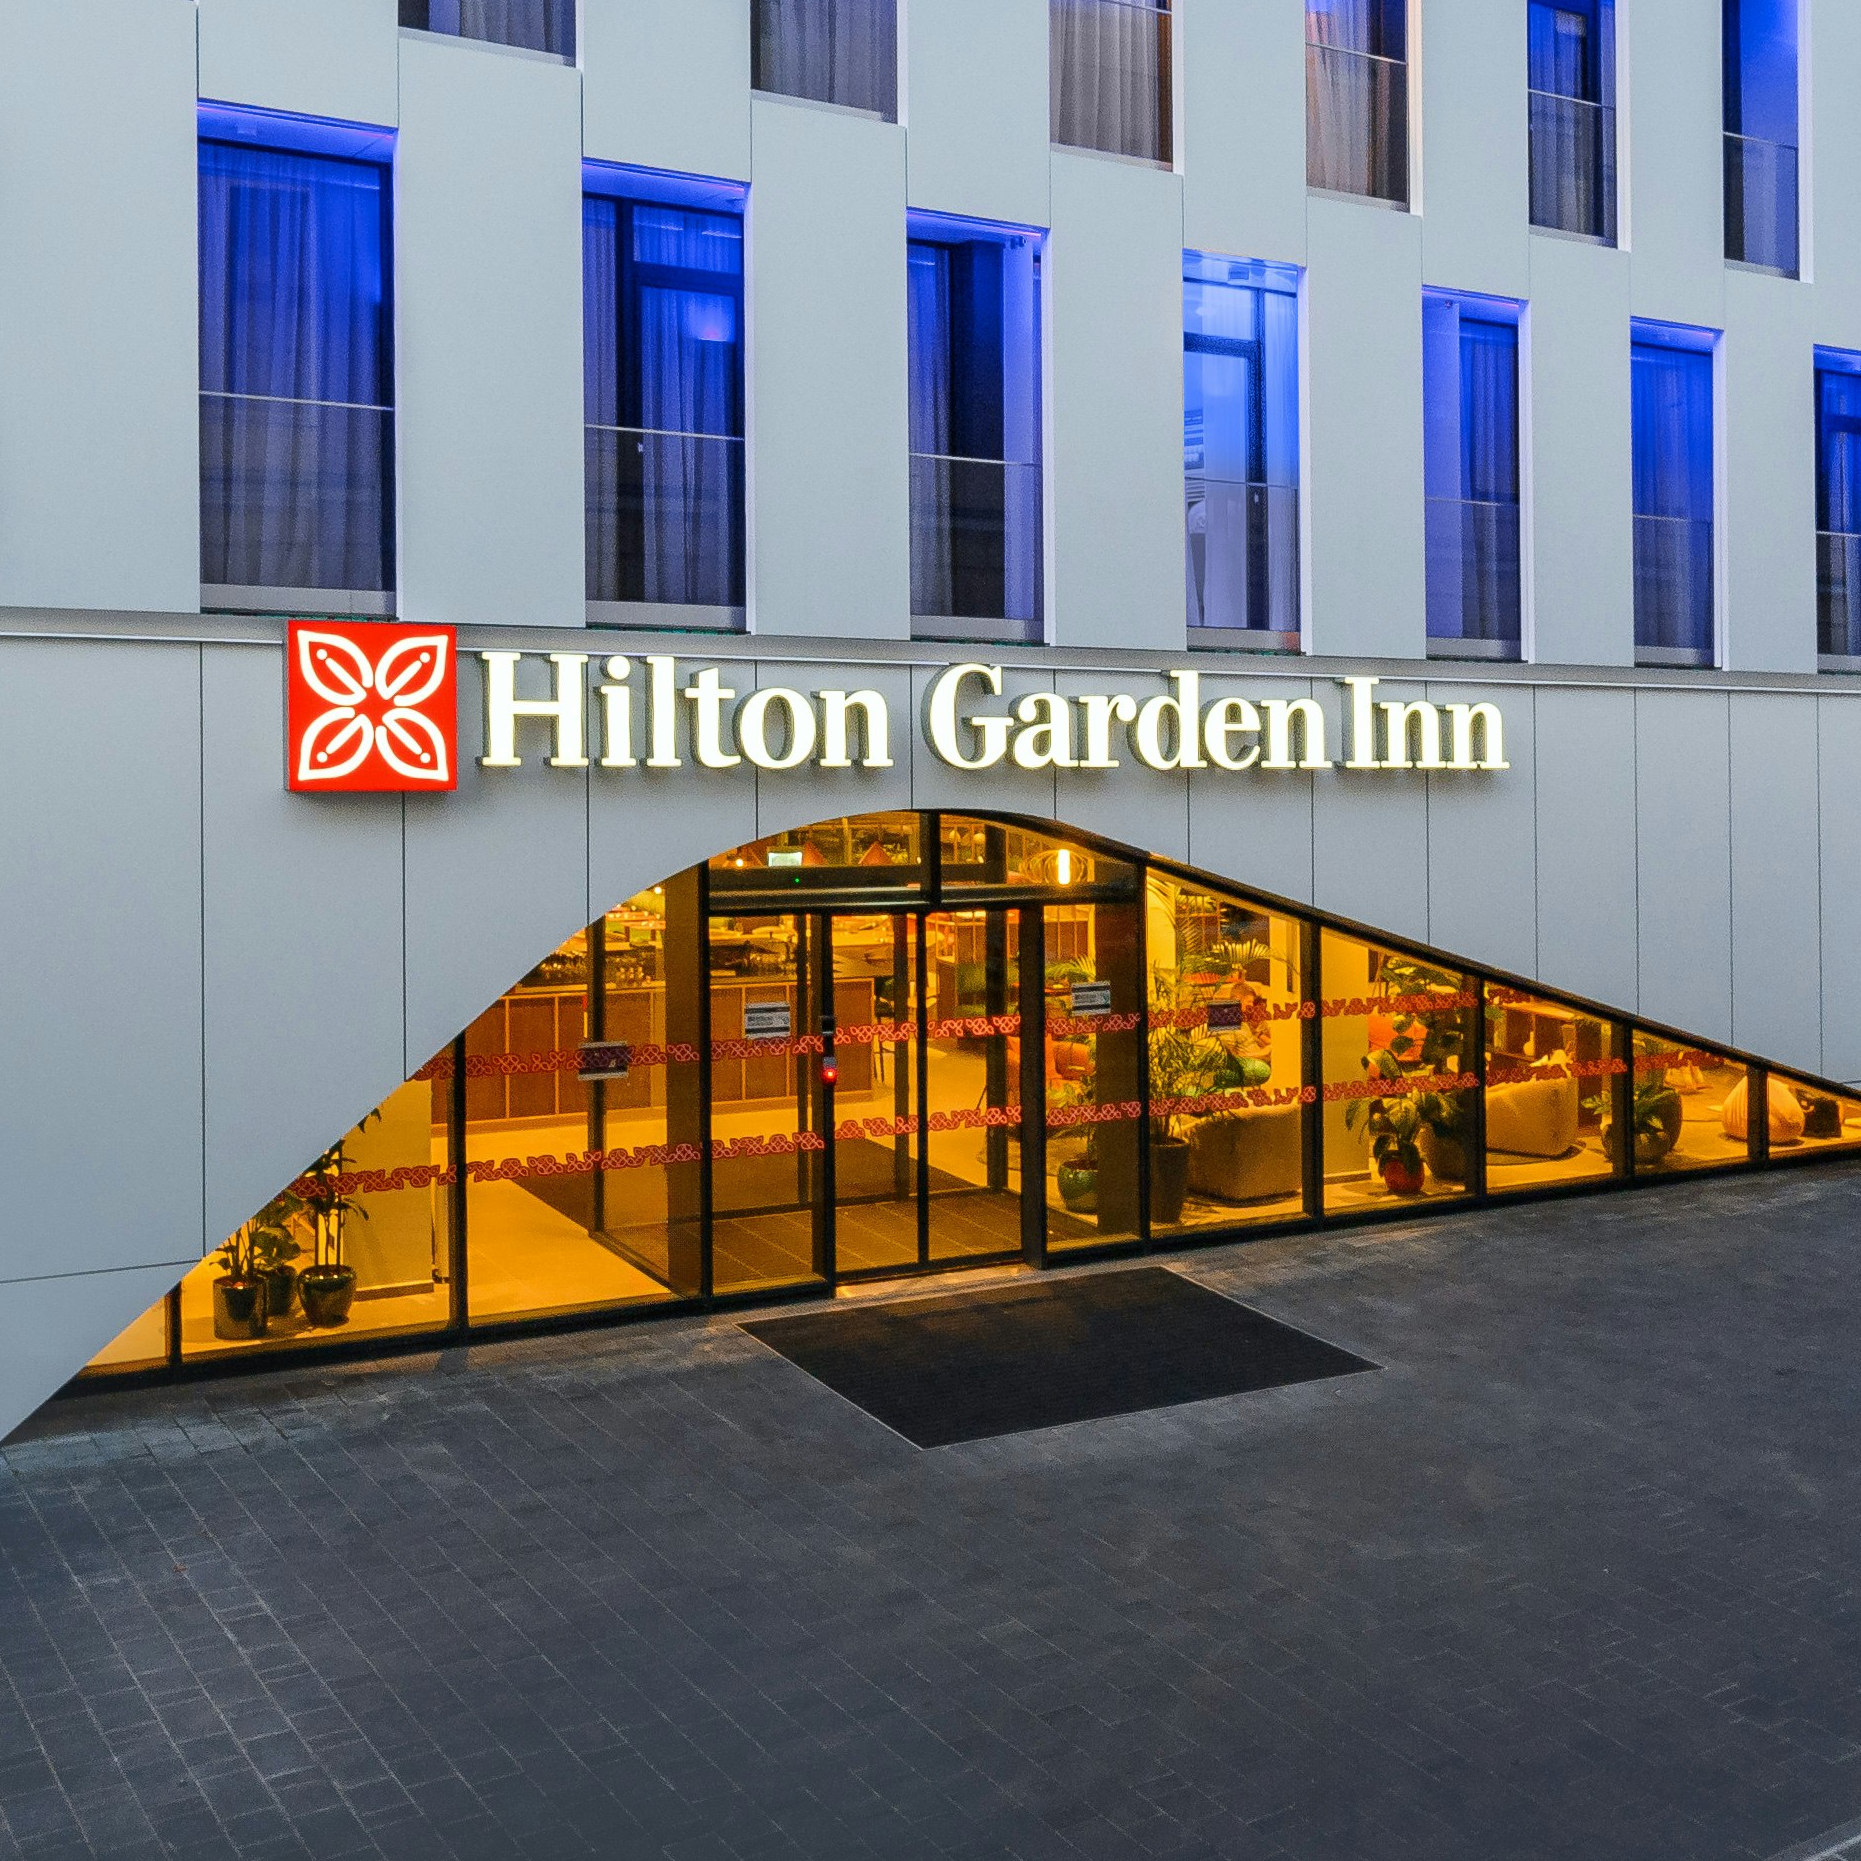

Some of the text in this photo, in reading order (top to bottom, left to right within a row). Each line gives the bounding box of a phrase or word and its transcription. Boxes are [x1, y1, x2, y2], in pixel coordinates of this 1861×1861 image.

[481, 650, 1511, 772] Hilton Garden Inn
